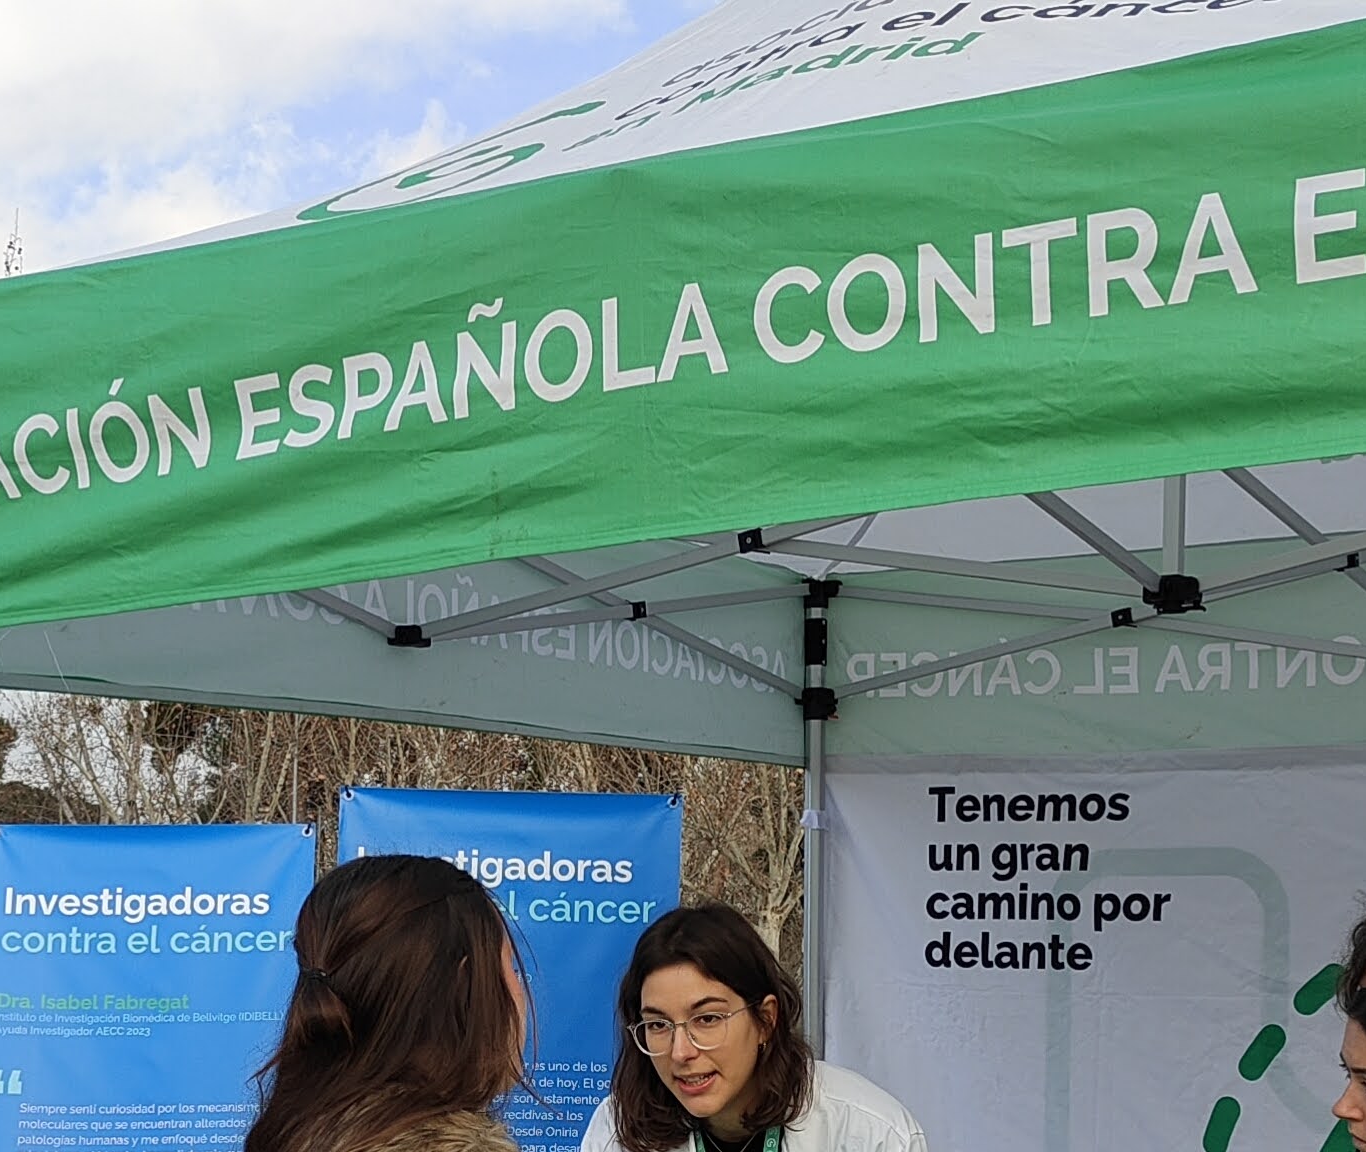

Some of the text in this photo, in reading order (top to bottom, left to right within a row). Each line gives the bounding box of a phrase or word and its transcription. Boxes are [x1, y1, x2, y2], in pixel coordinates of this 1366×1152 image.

[672, 31, 985, 115] Madrid
[234, 283, 728, 460] ESPAÑOLA
[752, 193, 1258, 363] CONTRA
[929, 786, 1130, 823] Tenemos
[929, 843, 1090, 881] un gran
[4, 886, 270, 923] Investigadoras
[528, 892, 656, 924] cáncer
[926, 883, 1171, 932] camino por
[1, 924, 293, 954] contra el cáncer
[925, 932, 1093, 971] delante
[38, 1013, 52, 1022] de
[54, 1013, 121, 1025] Investigación
[123, 1012, 175, 1023] Biomédica
[177, 1013, 190, 1022] de
[193, 1012, 236, 1024] Bellvitge
[40, 994, 98, 1010] Isabel
[104, 994, 189, 1013] Fabregat
[30, 1025, 94, 1037] Investigador
[96, 1026, 125, 1036] AECC
[126, 1027, 151, 1037] 2023
[548, 1062, 607, 1073] uno de los
[546, 1127, 578, 1137] Oniria
